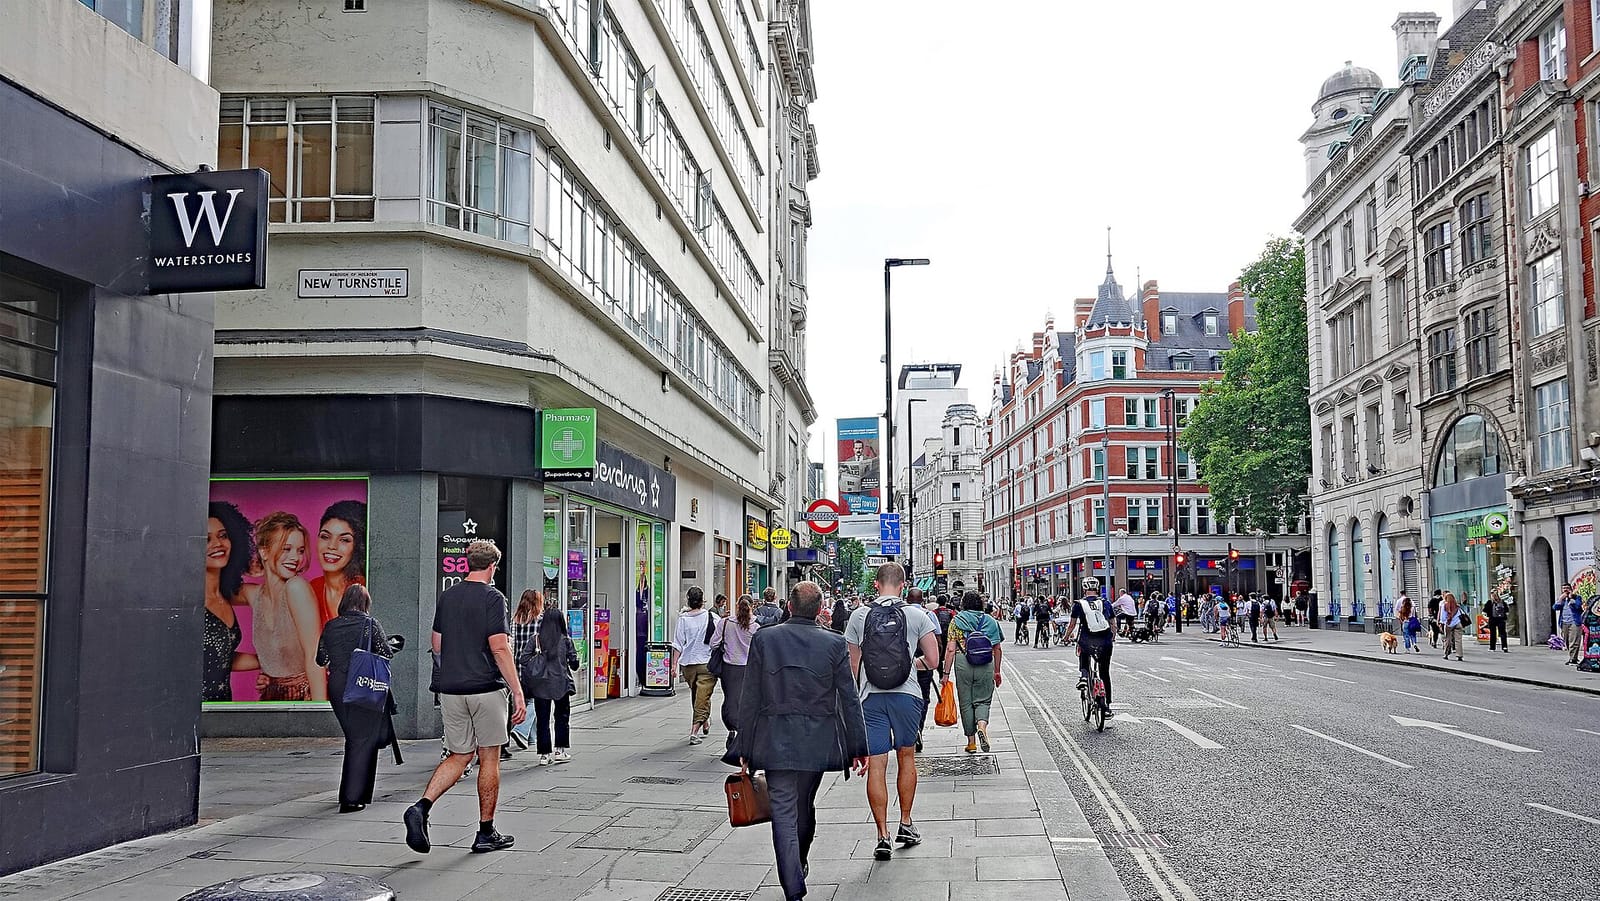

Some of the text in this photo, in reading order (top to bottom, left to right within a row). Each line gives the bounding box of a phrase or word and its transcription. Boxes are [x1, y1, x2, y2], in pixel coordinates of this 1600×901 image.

[167, 188, 244, 248] W
[154, 252, 251, 267] WATERSTONES
[304, 278, 402, 289] NEW TURNSTILE
[545, 414, 591, 423] Pharmacy
